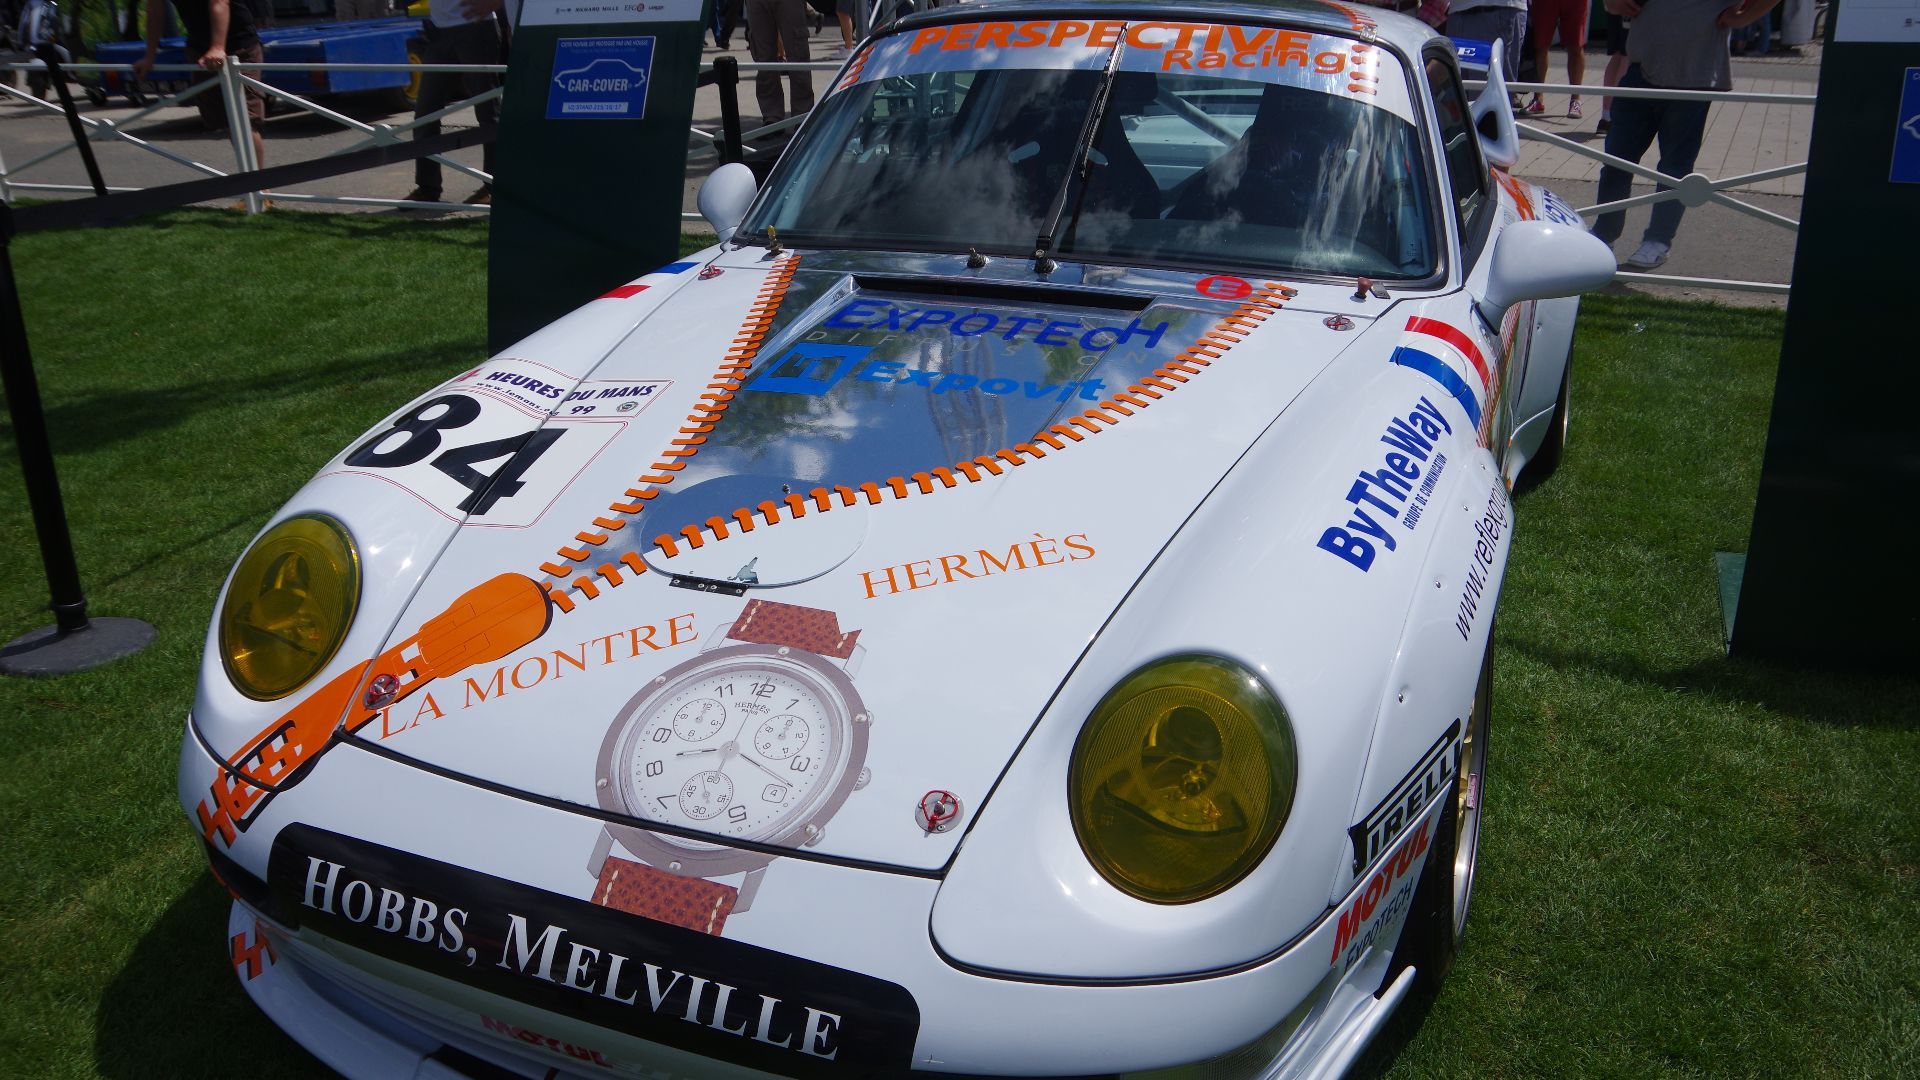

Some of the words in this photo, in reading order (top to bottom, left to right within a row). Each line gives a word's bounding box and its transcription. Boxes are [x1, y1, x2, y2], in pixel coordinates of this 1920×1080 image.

[908, 20, 1313, 58] PERSPECTIVE
[1161, 45, 1347, 75] Racing
[568, 78, 629, 92] CAR-COVER
[485, 371, 565, 399] HEURES
[562, 389, 597, 402] DU
[594, 384, 658, 400] MANS
[855, 359, 1107, 403] Expovit
[570, 405, 597, 415] 99
[343, 394, 569, 516] 84
[1419, 451, 1448, 498] COMMUNICATION
[1316, 395, 1452, 573] ByTheWay
[1414, 493, 1429, 506] DE
[1402, 502, 1424, 531] GROUPE
[376, 691, 438, 742] LA
[461, 612, 699, 711] MONTRE
[857, 532, 1098, 601] HERMÈS
[714, 683, 735, 698] 11
[1347, 717, 1462, 880] PIRELLI
[1330, 814, 1432, 967] MOTUL
[302, 855, 479, 968] HOBBS,
[496, 912, 844, 1062] MELVILLE
